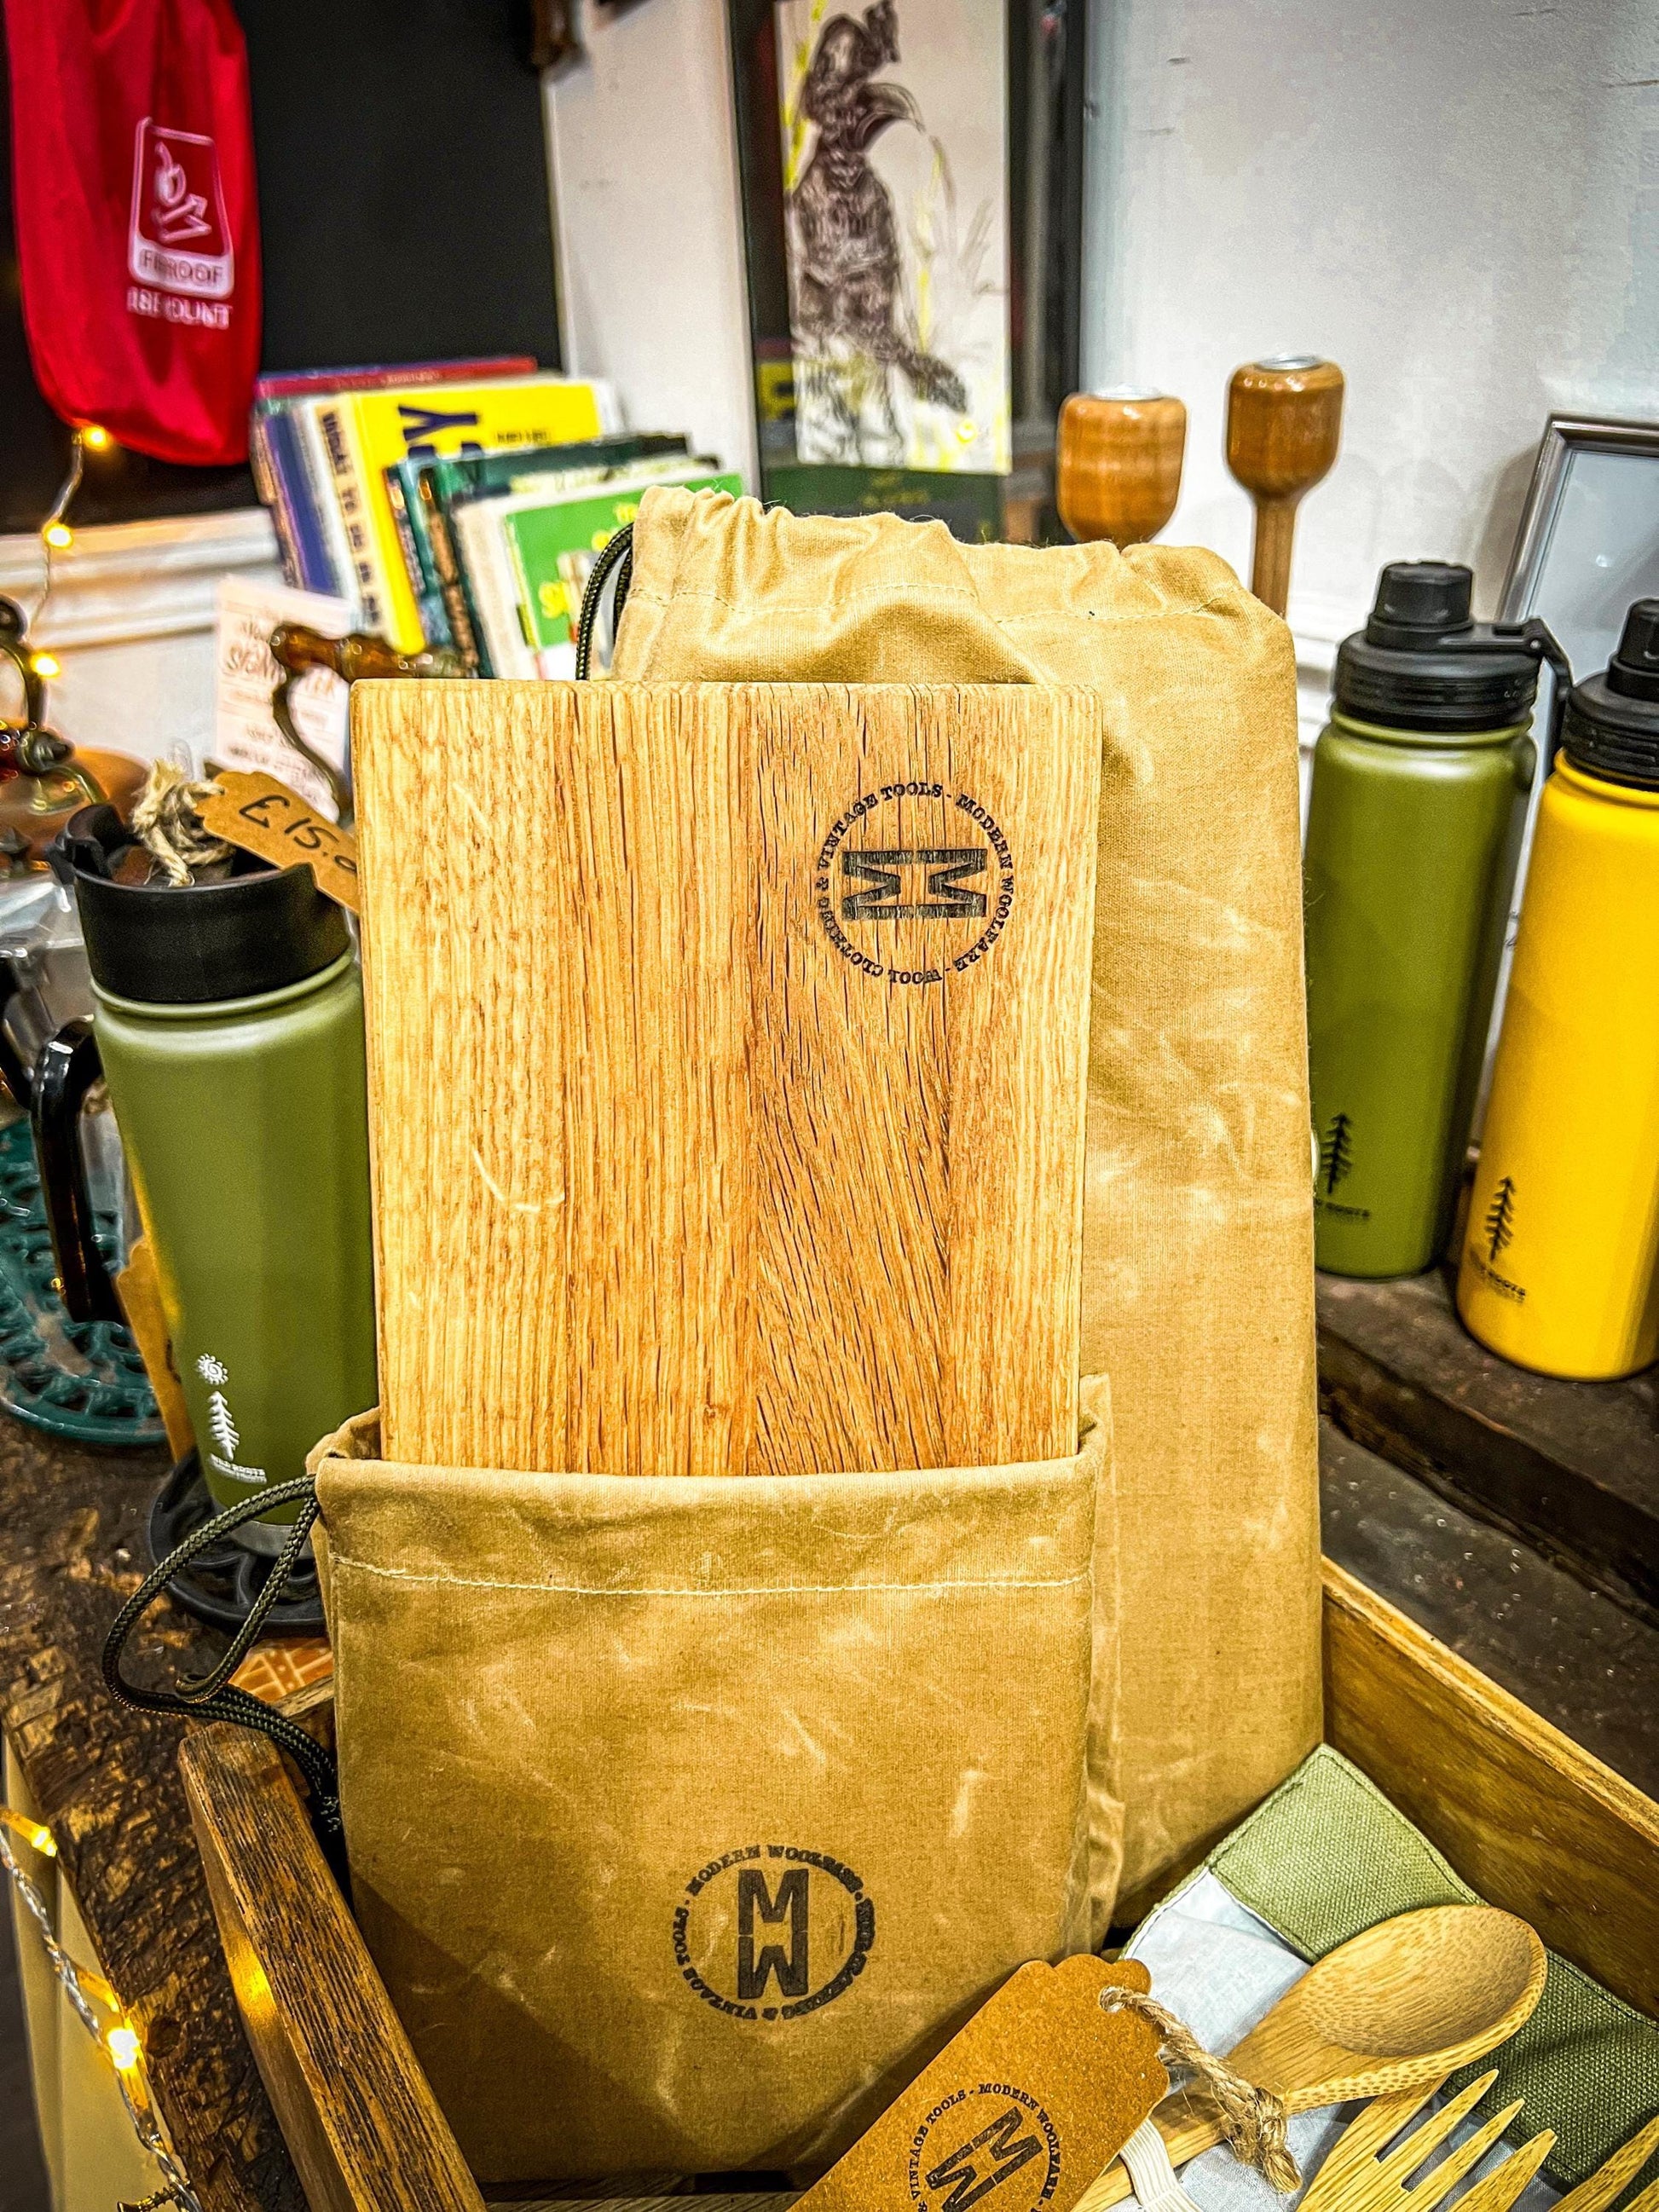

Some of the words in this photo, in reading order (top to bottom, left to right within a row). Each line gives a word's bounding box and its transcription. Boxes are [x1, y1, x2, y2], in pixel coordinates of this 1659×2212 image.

[880, 781, 943, 802] TOOLS
[817, 794, 878, 871] VINTAGE
[954, 793, 1014, 870] MODERN
[816, 896, 884, 979] CLOTHING
[953, 874, 1015, 973] WOOLFARE
[888, 968, 943, 985] WOOL
[685, 1844, 761, 1897] MODERN
[908, 2125, 929, 2201] VINTAGE
[927, 2088, 967, 2125] TOOLS
[978, 2082, 1040, 2111] MODERN
[1036, 2108, 1061, 2199] WOOLFARE
